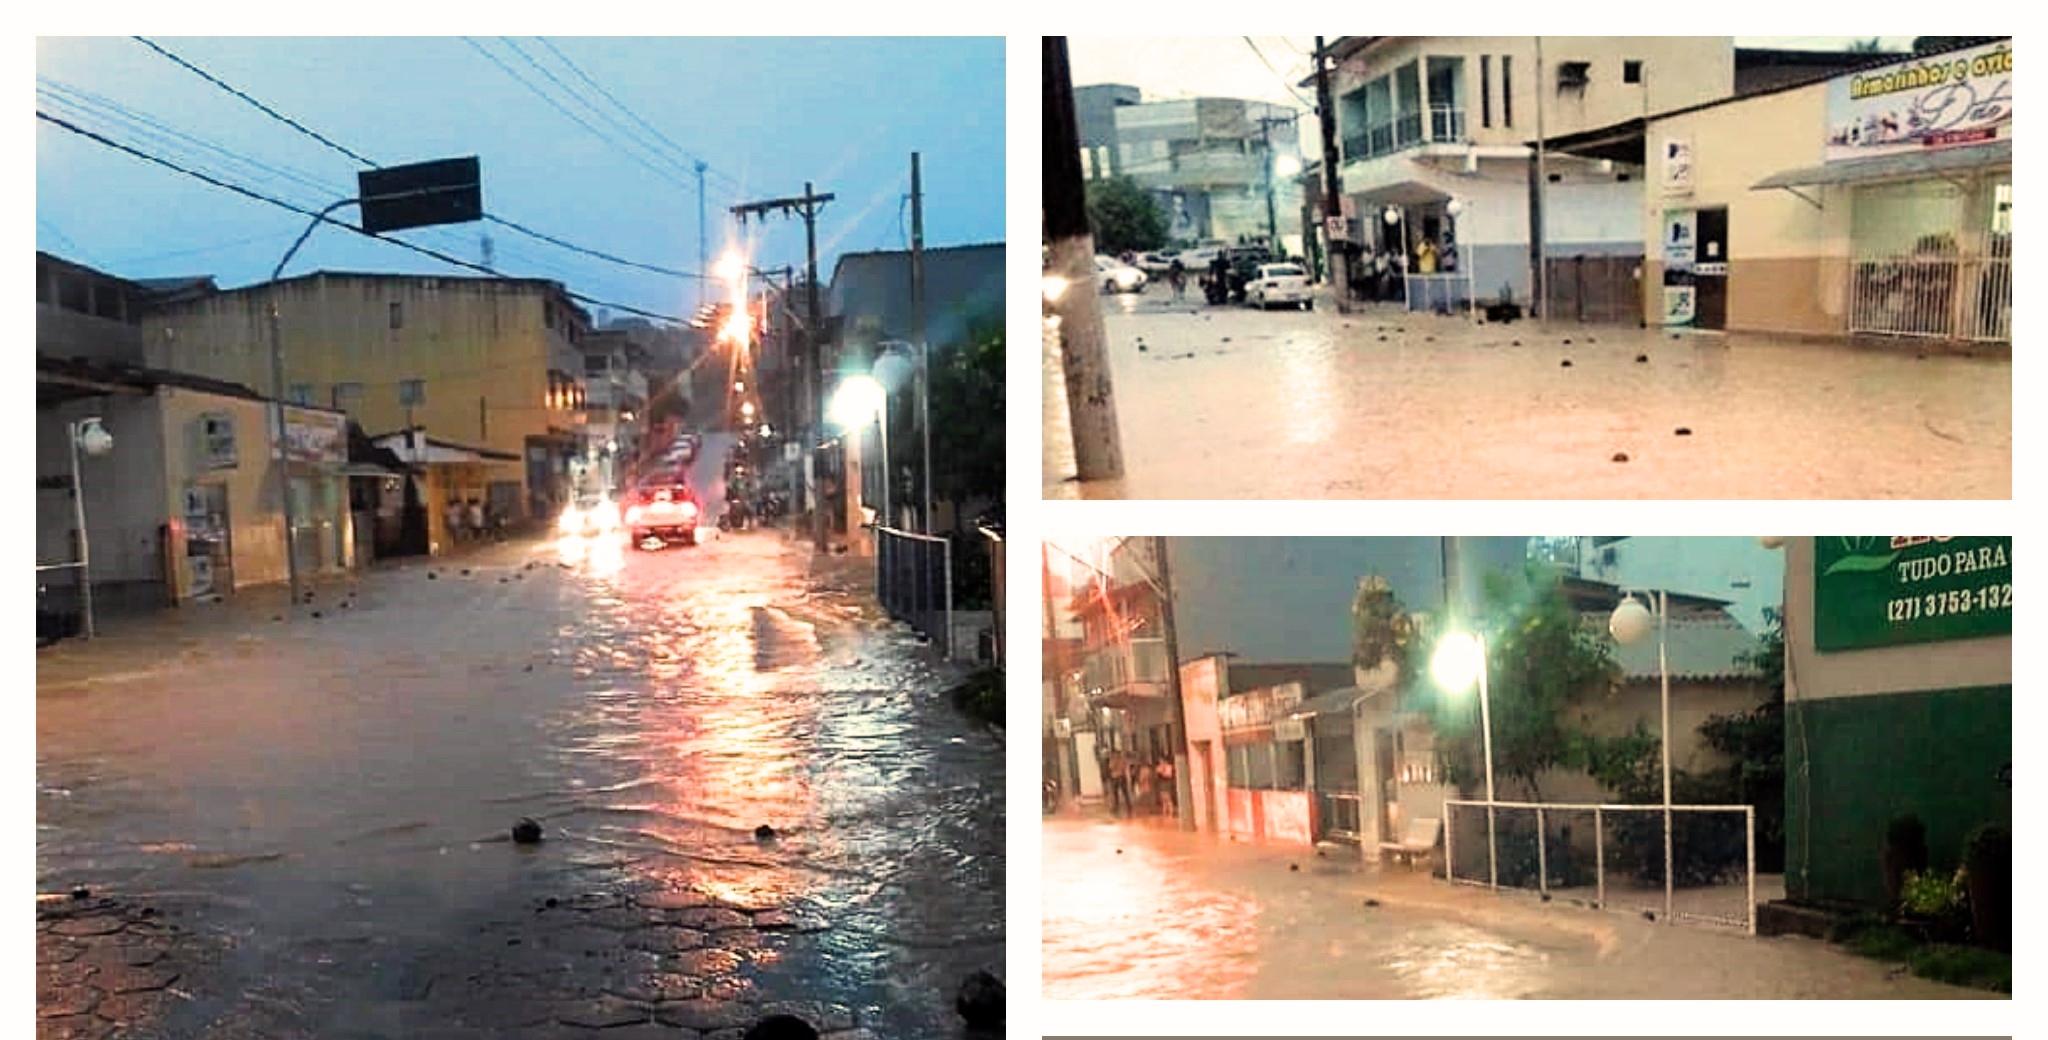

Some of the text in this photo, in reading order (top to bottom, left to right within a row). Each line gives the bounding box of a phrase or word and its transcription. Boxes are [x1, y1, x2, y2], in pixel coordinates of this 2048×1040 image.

[1850, 62, 1951, 99] Armarinhos
[1953, 58, 1967, 80] e
[1899, 543, 2008, 583] TUDO PARA
[1888, 597, 1920, 621] (27)
